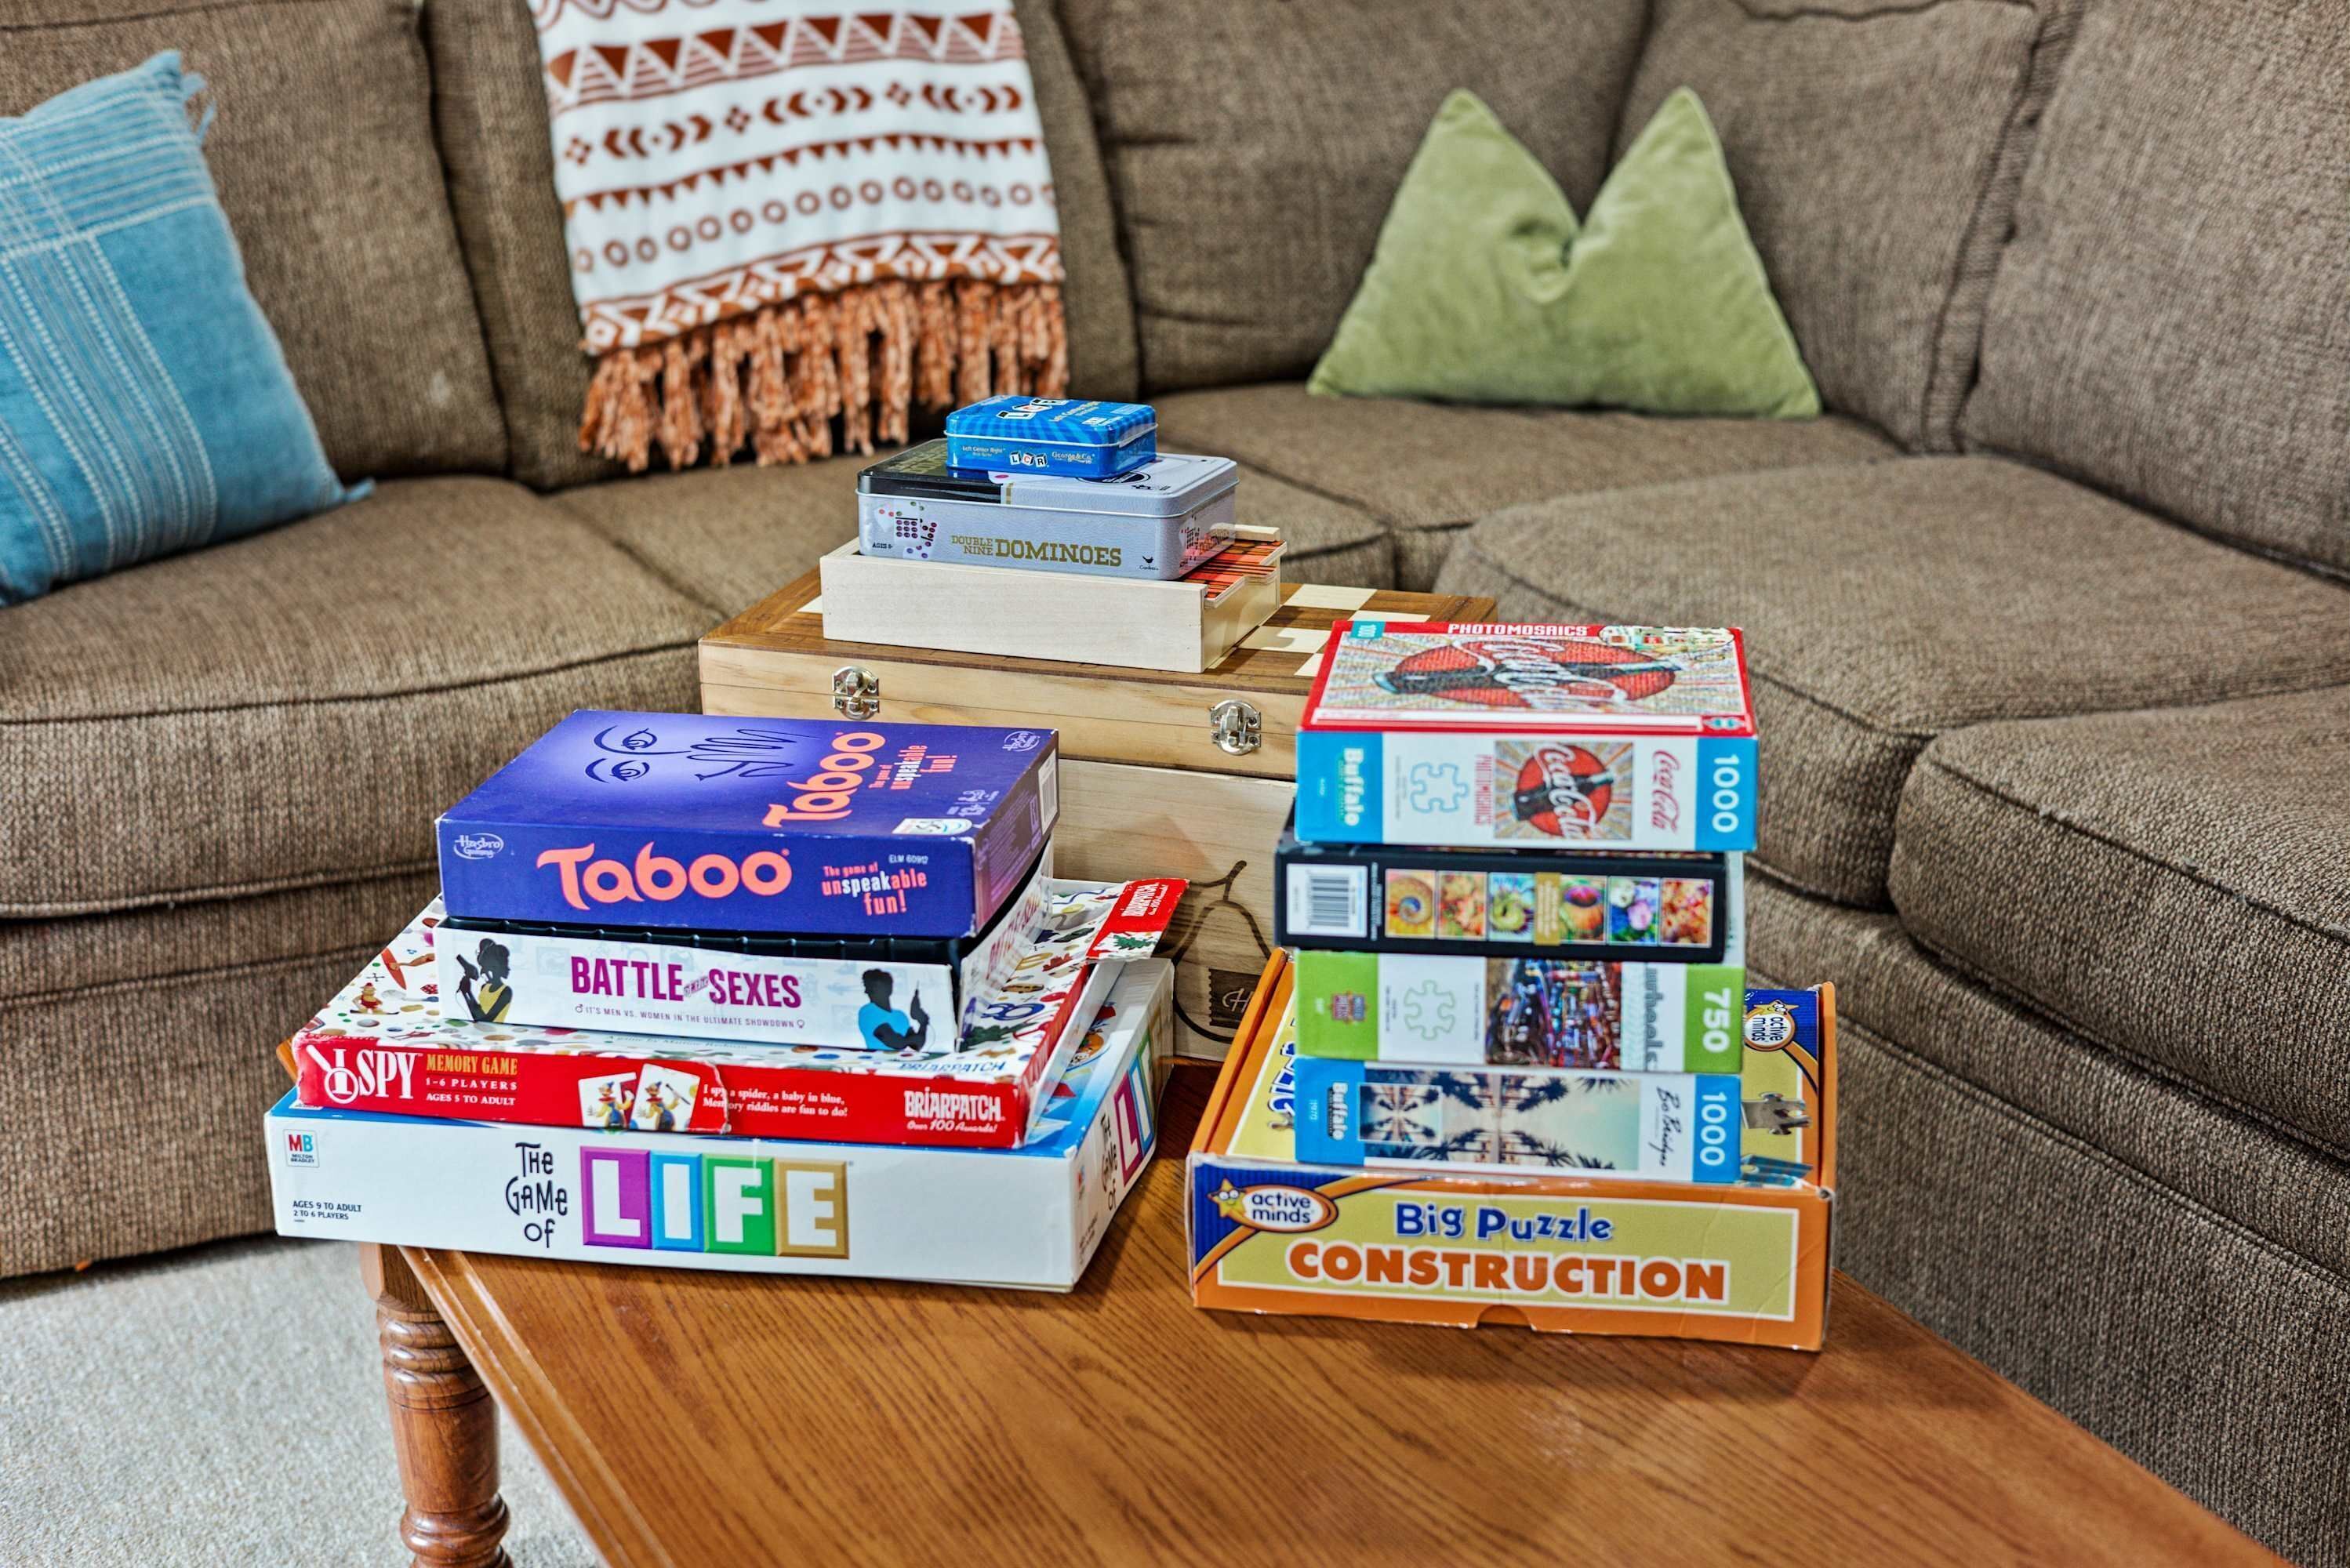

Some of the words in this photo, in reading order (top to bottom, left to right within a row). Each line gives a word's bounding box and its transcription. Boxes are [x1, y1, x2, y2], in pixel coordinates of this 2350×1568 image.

[951, 535, 993, 546] DOUBLE
[964, 546, 993, 556] NINE
[995, 539, 1121, 567] DOMINOES
[1447, 623, 1588, 637] PHOTOMOSAICS
[762, 731, 886, 828] Taboo
[1343, 748, 1365, 826] Buffalo
[1712, 754, 1740, 833] 1000
[455, 835, 500, 850] Hasbro
[536, 841, 793, 910] Taboo
[823, 865, 841, 877] The
[842, 866, 866, 878] game
[868, 862, 878, 873] of
[822, 868, 928, 898] unspeakable
[864, 888, 907, 916] fun!
[571, 956, 684, 1002] BATTLE
[708, 968, 802, 1008] SEXES
[586, 1007, 601, 1015] IT'S
[604, 1008, 621, 1017] MEN
[641, 1011, 671, 1021] WOMEN
[674, 1013, 684, 1022] IN
[686, 1013, 701, 1022] THE
[703, 1014, 743, 1025] ULTIMATE
[746, 1018, 795, 1029] SHOWDOWN
[1702, 988, 1732, 1054] 750
[1752, 1017, 1766, 1043] minds
[1769, 1016, 1784, 1042] active
[357, 1048, 419, 1100] SPY
[426, 1052, 477, 1073] MEMORY
[481, 1056, 518, 1076] GAME
[426, 1076, 446, 1087] 1-6
[451, 1078, 518, 1091] PLAYERS
[703, 1084, 708, 1094] I
[738, 1088, 771, 1101] spider,
[782, 1091, 805, 1104] baby
[808, 1092, 818, 1102] in
[820, 1094, 845, 1105] blue,
[426, 1093, 452, 1102] AGES
[455, 1094, 460, 1103] 5
[463, 1094, 478, 1104] TO
[481, 1095, 515, 1106] ADULT
[746, 1102, 779, 1112] riddles
[799, 1105, 816, 1115] fun
[818, 1107, 829, 1116] to
[831, 1106, 848, 1117] do!
[1331, 1082, 1349, 1141] Buffalo
[906, 1120, 928, 1131] Over
[929, 1118, 955, 1131] 100
[954, 1121, 998, 1134] Awards!
[1699, 1091, 1727, 1167] 1000
[288, 1134, 314, 1153] MB
[293, 1200, 314, 1209] AGES
[323, 1202, 334, 1210] TO
[336, 1203, 362, 1213] ADULT
[591, 1159, 837, 1247] LIFE
[1251, 1192, 1311, 1208] active
[318, 1211, 349, 1220] PLAYERS
[1252, 1206, 1311, 1224] minds
[1396, 1203, 1464, 1239] Big
[1476, 1207, 1613, 1241] Puzzle
[1288, 1241, 1727, 1302] CONSTRUCTION
